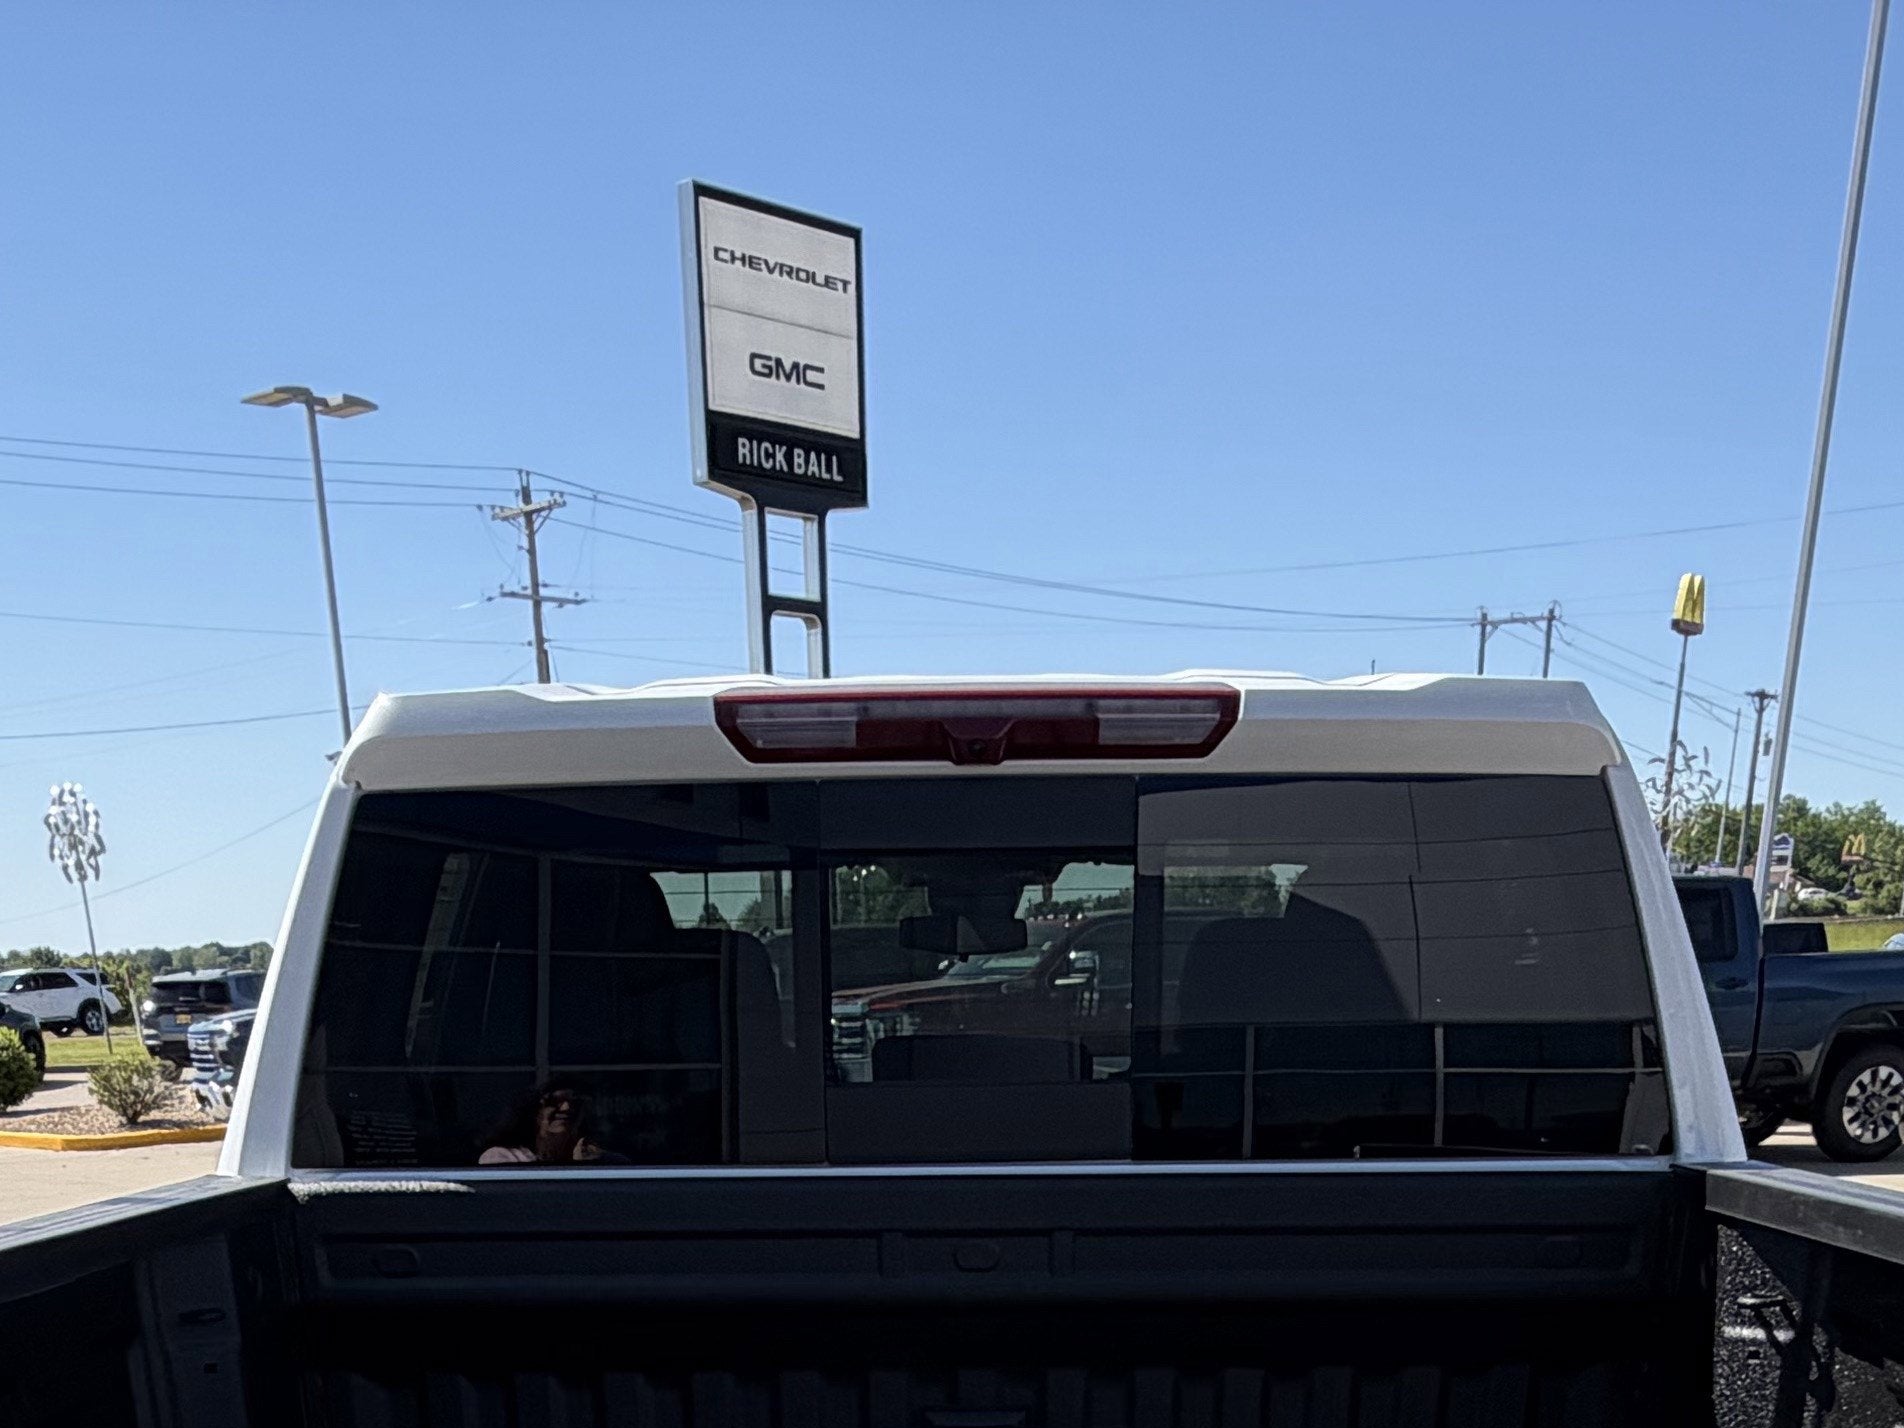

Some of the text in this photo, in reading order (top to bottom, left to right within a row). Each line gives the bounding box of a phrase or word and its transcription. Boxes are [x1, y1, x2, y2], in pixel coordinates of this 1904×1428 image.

[713, 246, 851, 293] CHEVROLET
[749, 352, 826, 390] GMC
[737, 437, 844, 481] RICK BALL
